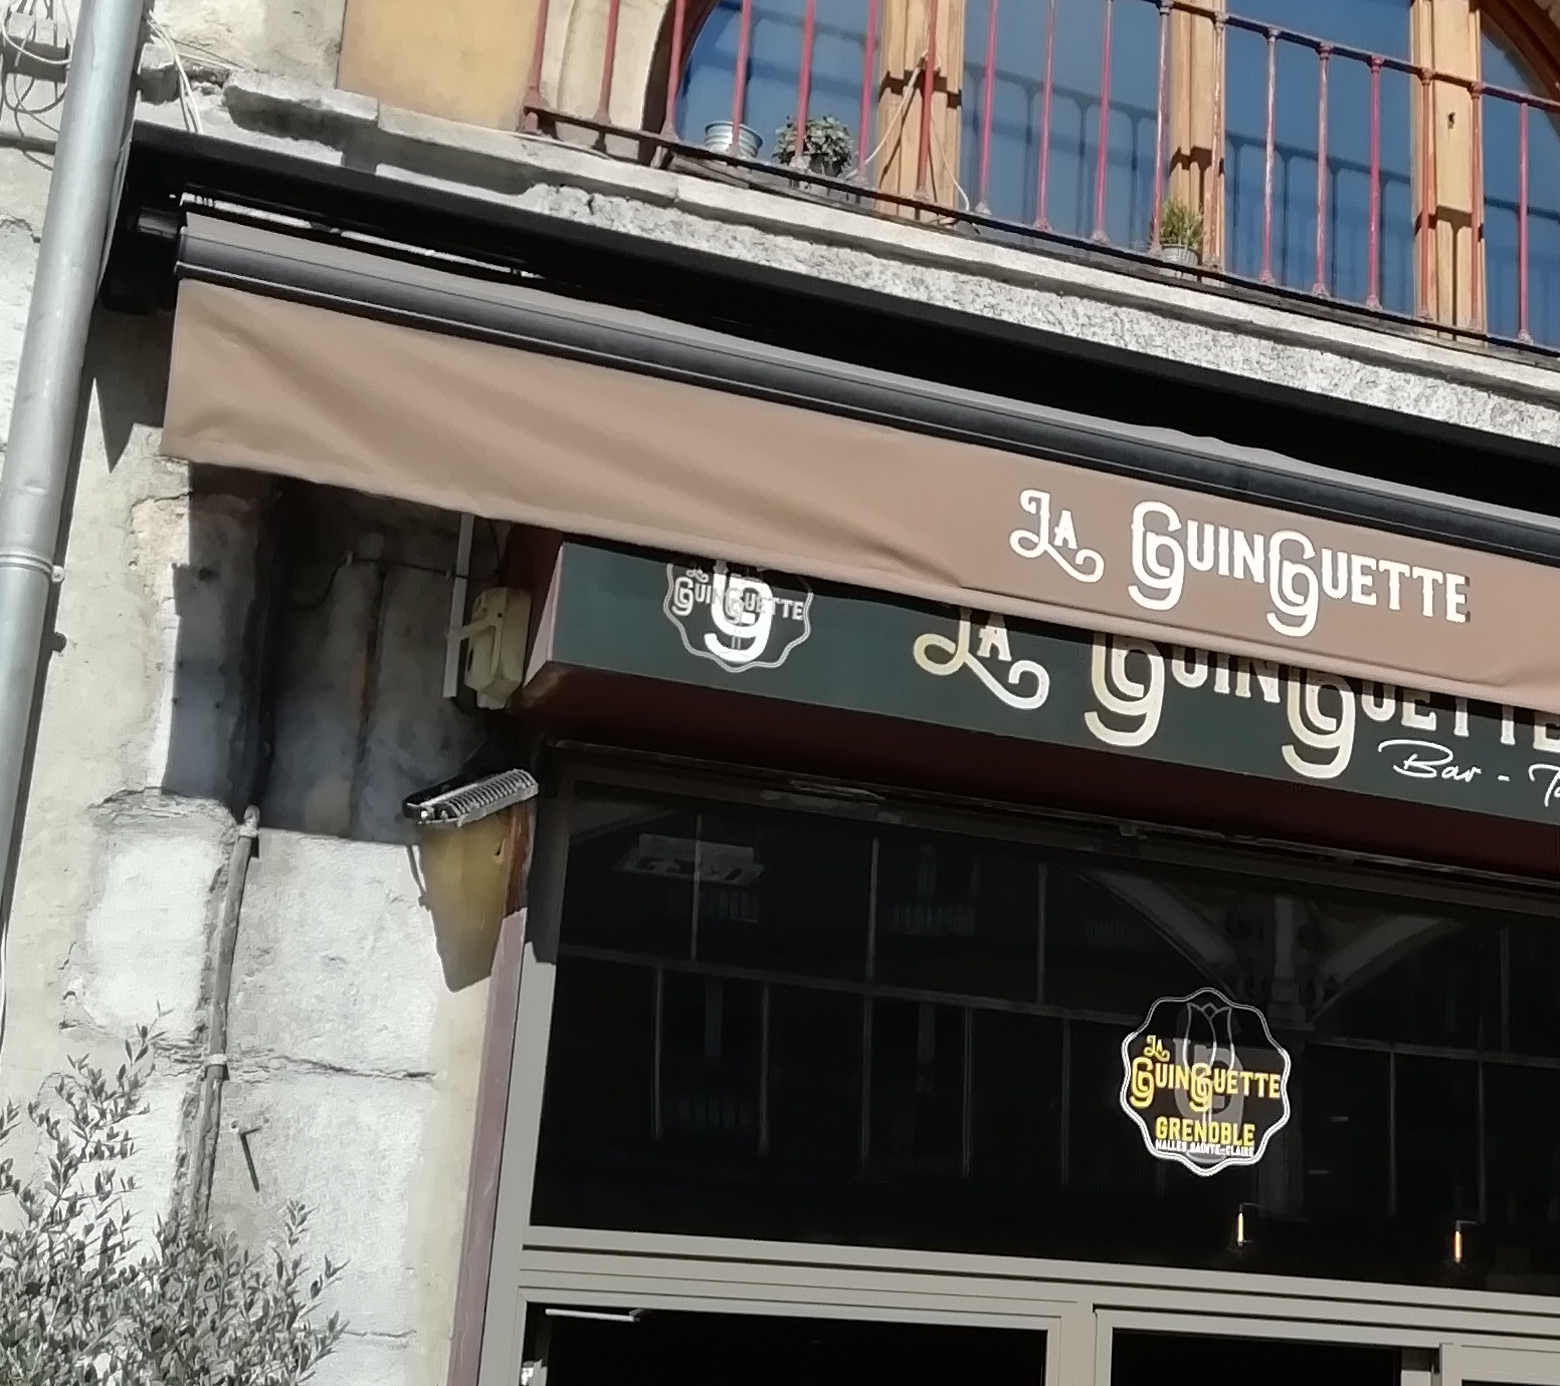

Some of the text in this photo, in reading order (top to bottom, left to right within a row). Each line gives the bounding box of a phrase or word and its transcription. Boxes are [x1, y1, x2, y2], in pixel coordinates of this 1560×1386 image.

[1008, 488, 1469, 637] LA GUINGUETTE
[1378, 738, 1483, 784] Bar
[1129, 1056, 1282, 1113] GUINGUETTE
[1156, 1116, 1255, 1146] GRENOBLE
